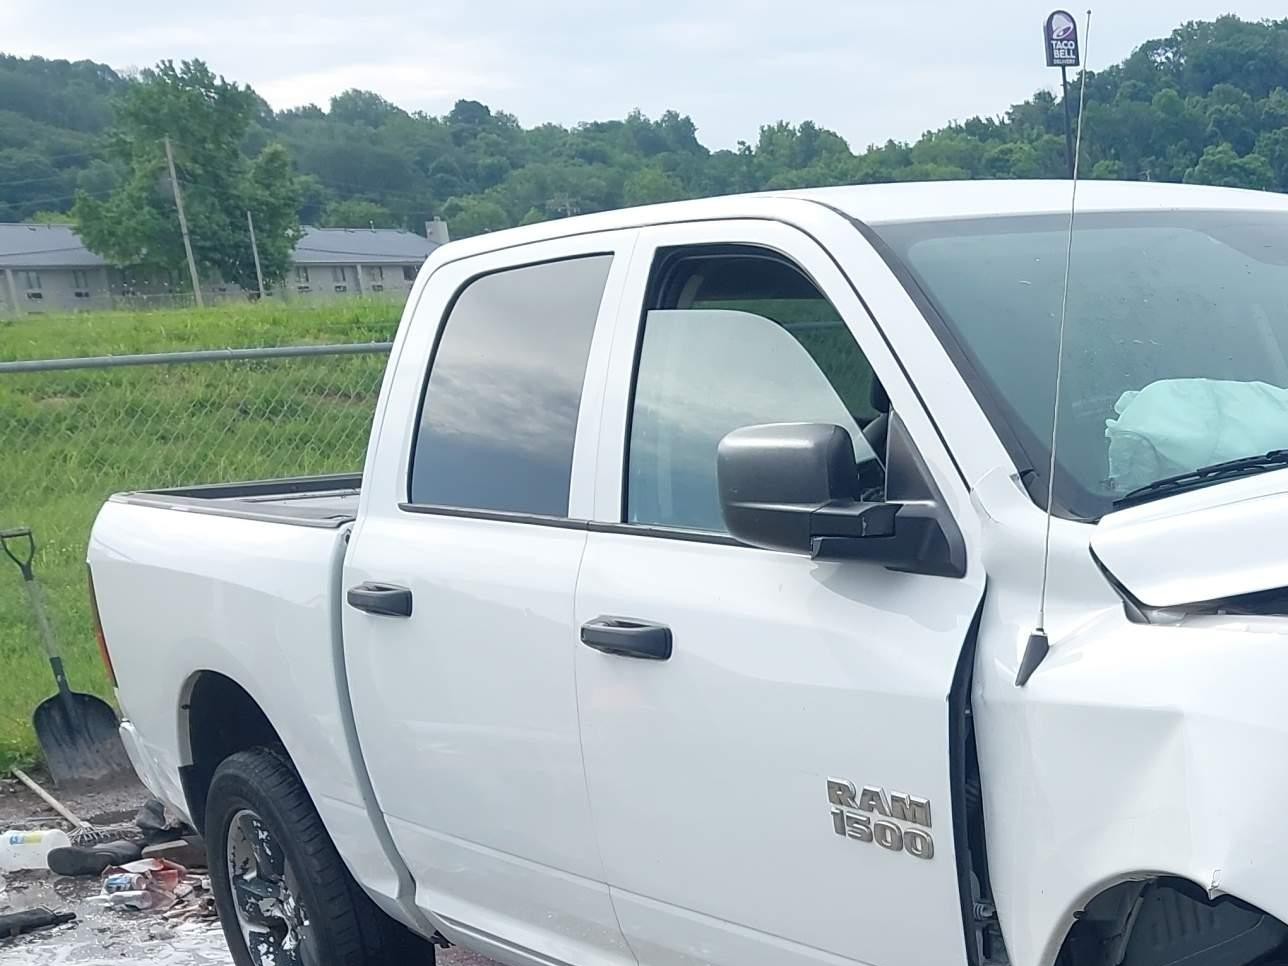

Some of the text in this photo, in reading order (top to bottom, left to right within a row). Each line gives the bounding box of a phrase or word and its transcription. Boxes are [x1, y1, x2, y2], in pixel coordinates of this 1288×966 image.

[1051, 40, 1075, 49] TACO
[1053, 49, 1076, 58] BELL
[826, 776, 932, 829] RAM
[830, 806, 935, 860] 1500
